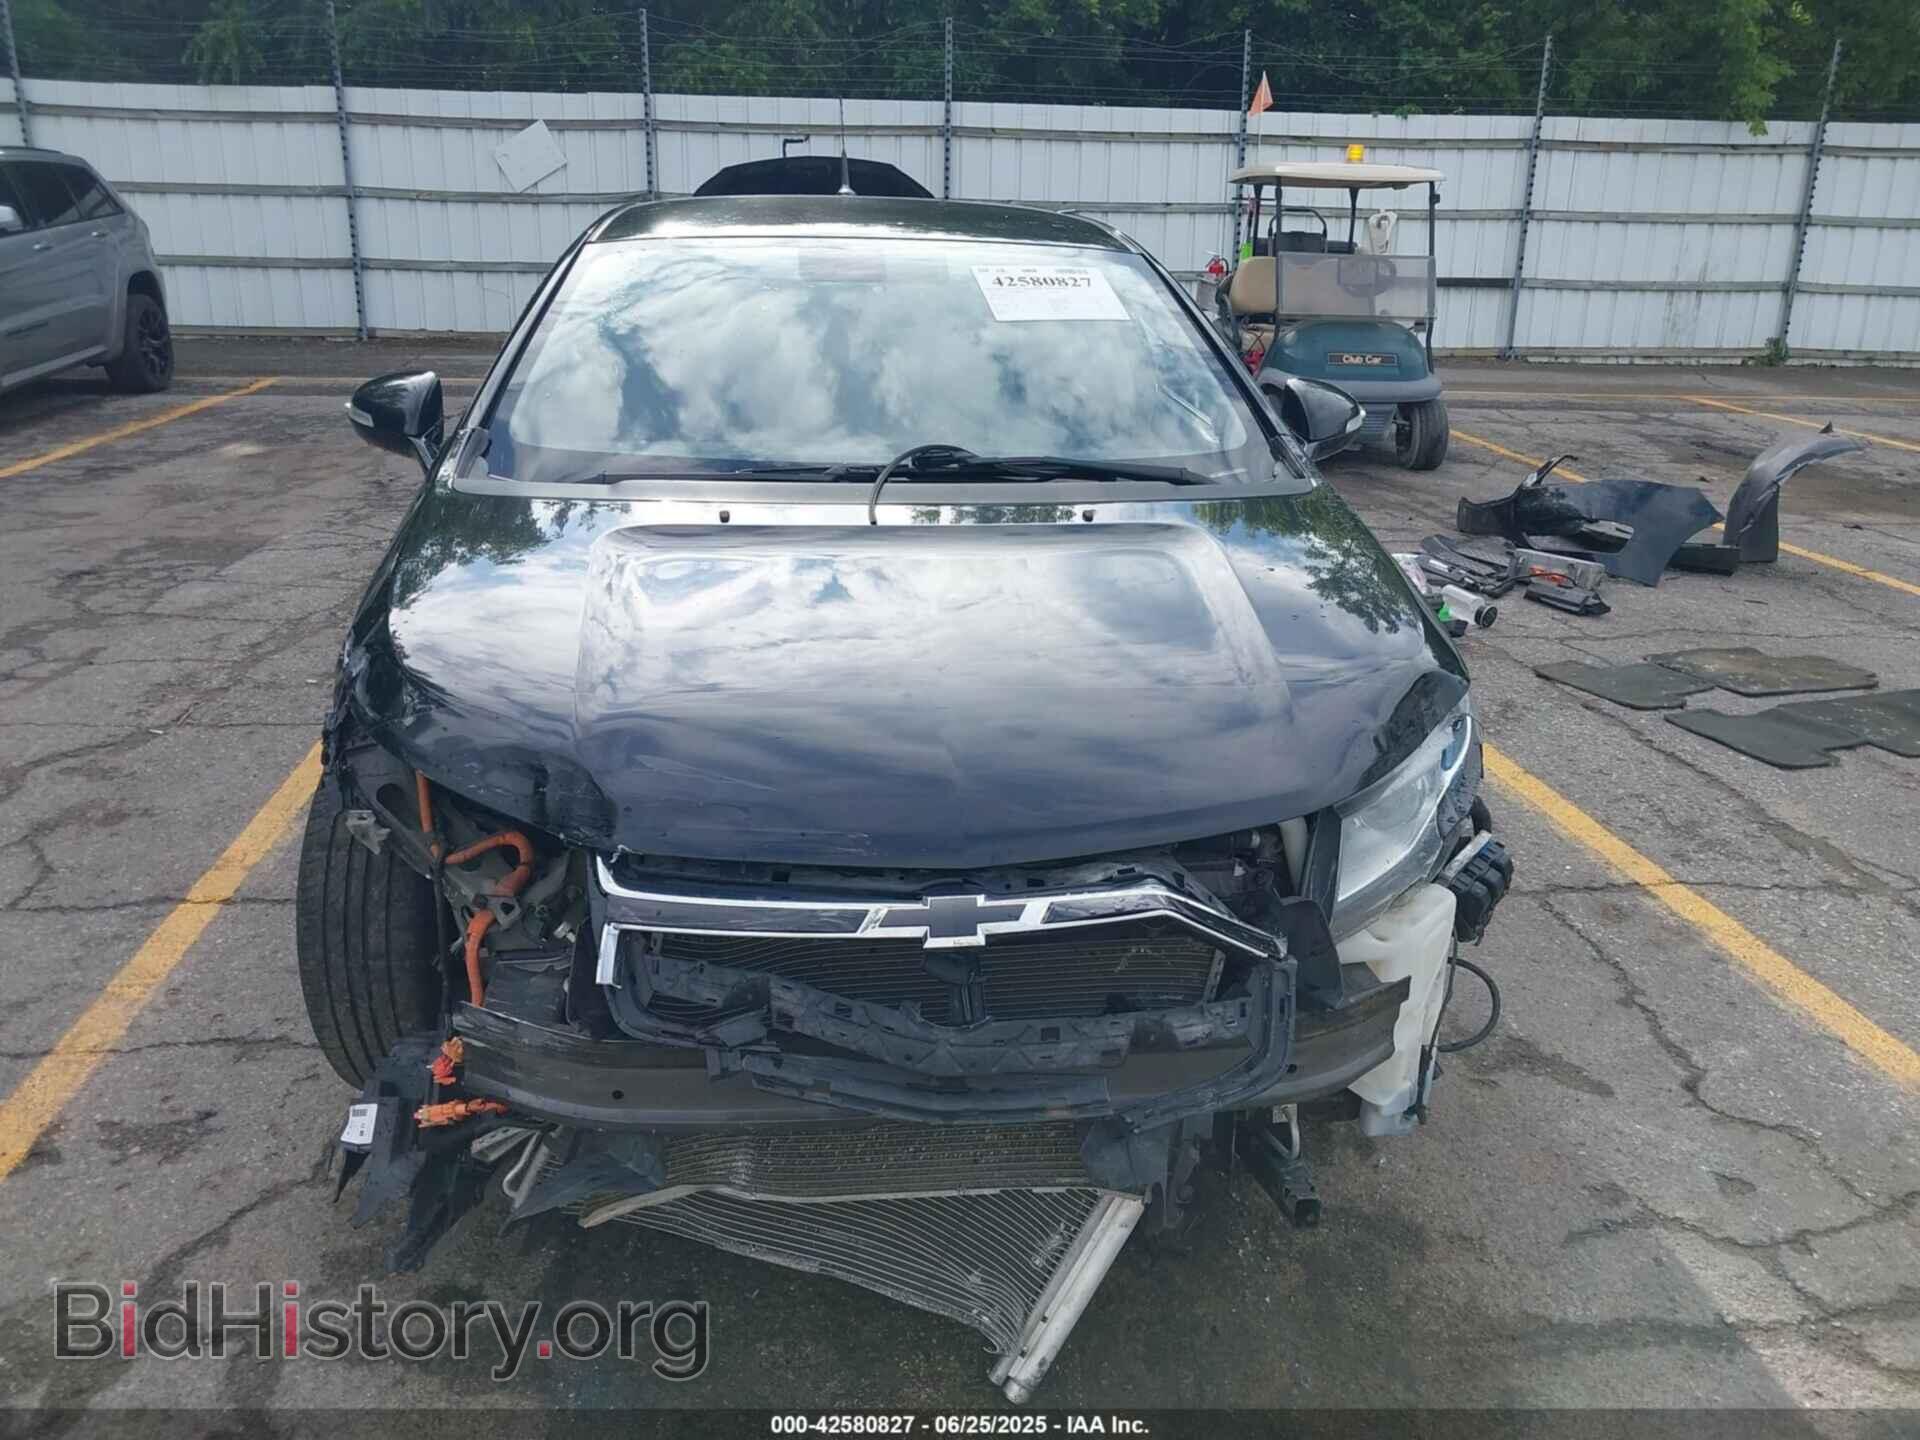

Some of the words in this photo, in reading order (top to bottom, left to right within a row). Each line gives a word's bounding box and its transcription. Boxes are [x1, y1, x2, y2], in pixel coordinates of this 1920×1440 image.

[992, 275, 1091, 288] 42580827
[1342, 353, 1363, 365] Club
[1365, 353, 1382, 365] Car
